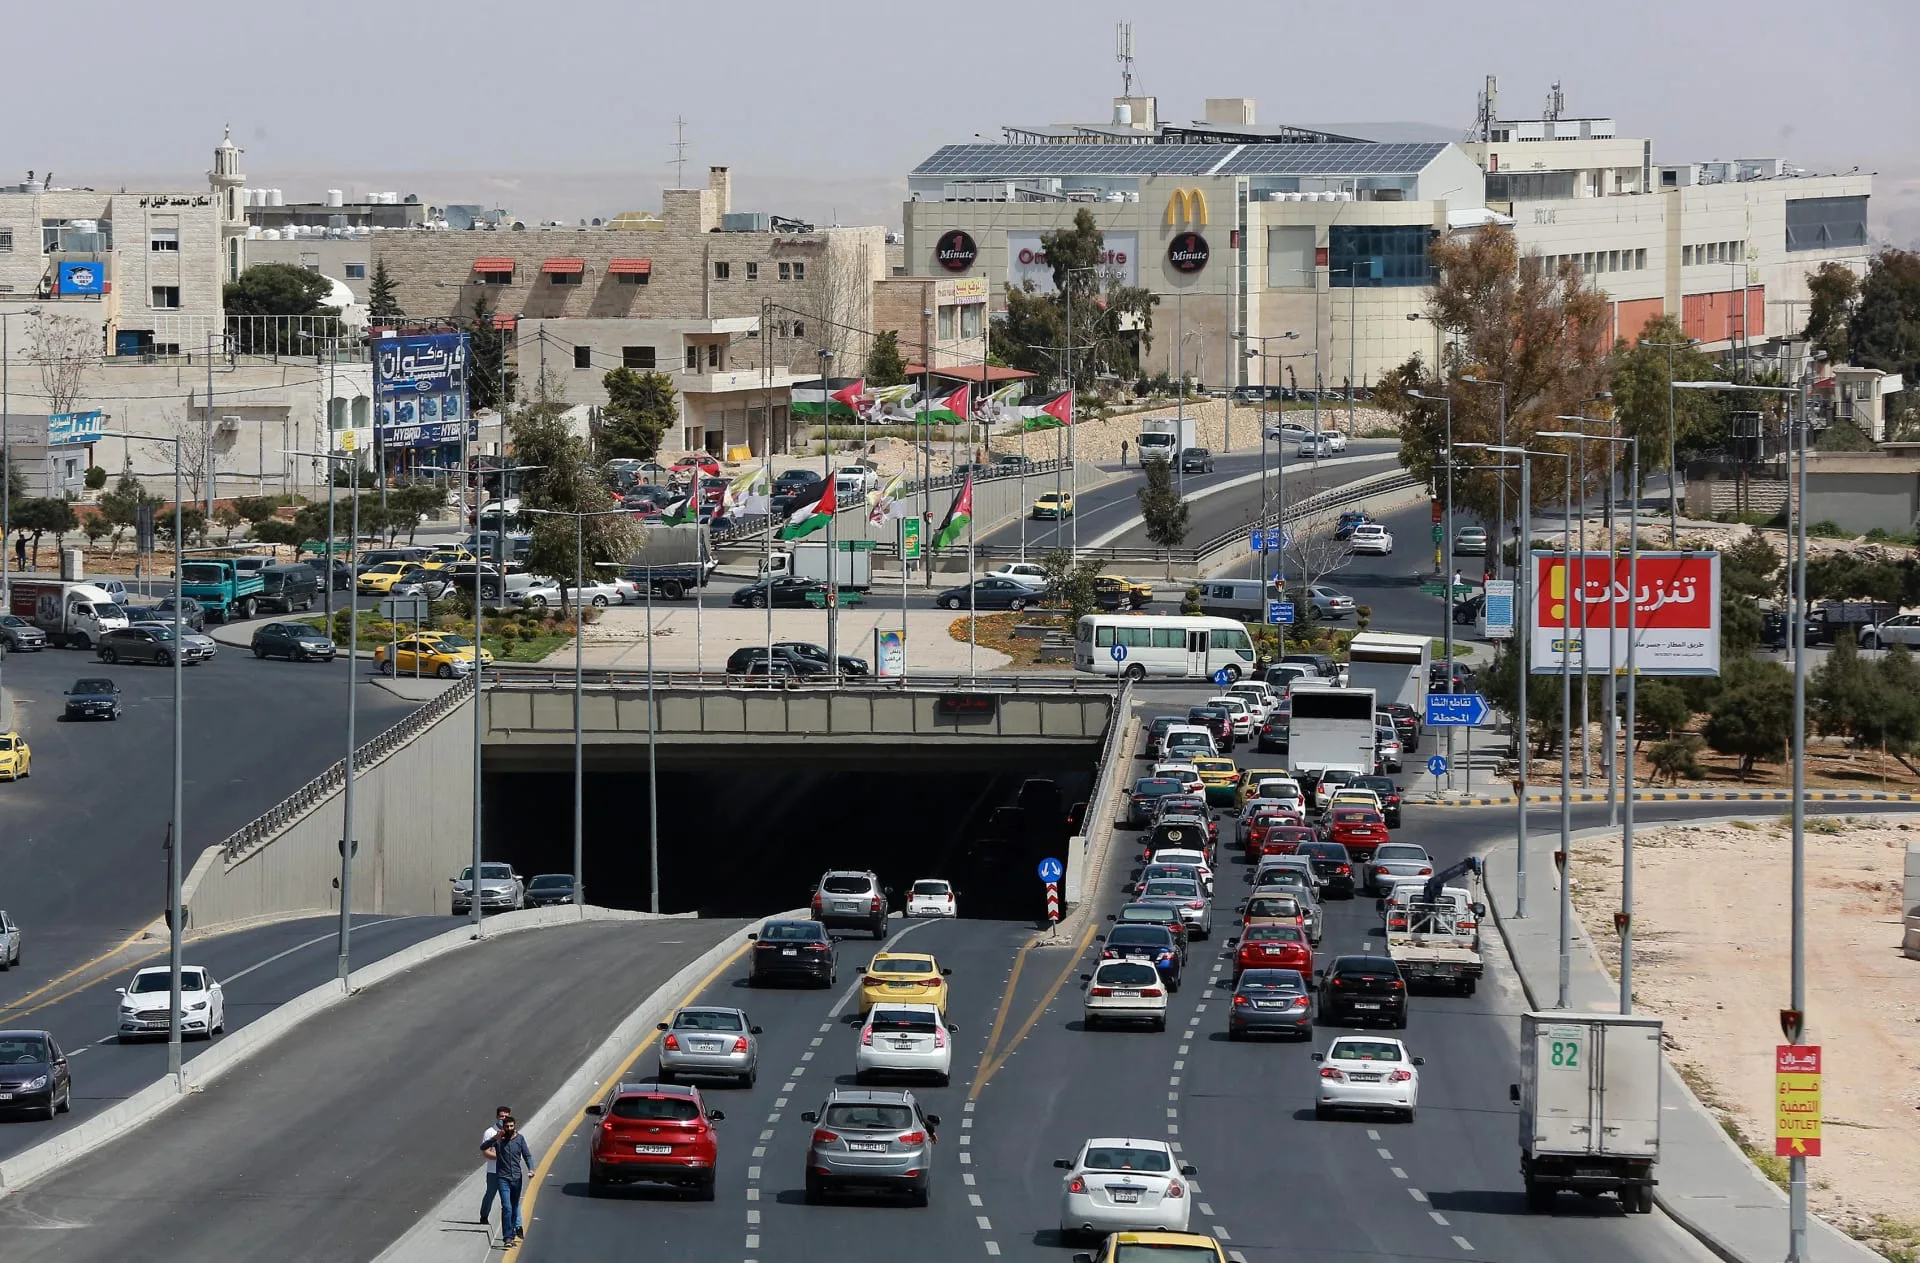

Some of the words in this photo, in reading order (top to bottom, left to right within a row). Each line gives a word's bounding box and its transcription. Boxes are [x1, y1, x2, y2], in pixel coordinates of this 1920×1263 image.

[139, 196, 150, 208] ابو
[151, 195, 168, 208] خليل
[170, 197, 190, 206] محمد
[191, 196, 212, 207] اسكان
[940, 249, 974, 260] Minute
[1019, 247, 1047, 265] On
[1172, 250, 1207, 261] Minute
[393, 427, 421, 443] HYBRID
[441, 423, 468, 439] HYBRD
[1667, 641, 1687, 649] المطار
[1687, 641, 1704, 649] طريق
[1449, 697, 1471, 711] تقاطع
[1432, 712, 1469, 723] المحطة
[1552, 1042, 1578, 1067] 82
[1780, 1101, 1819, 1115] التصفية
[1779, 1119, 1819, 1130] OUTLET
